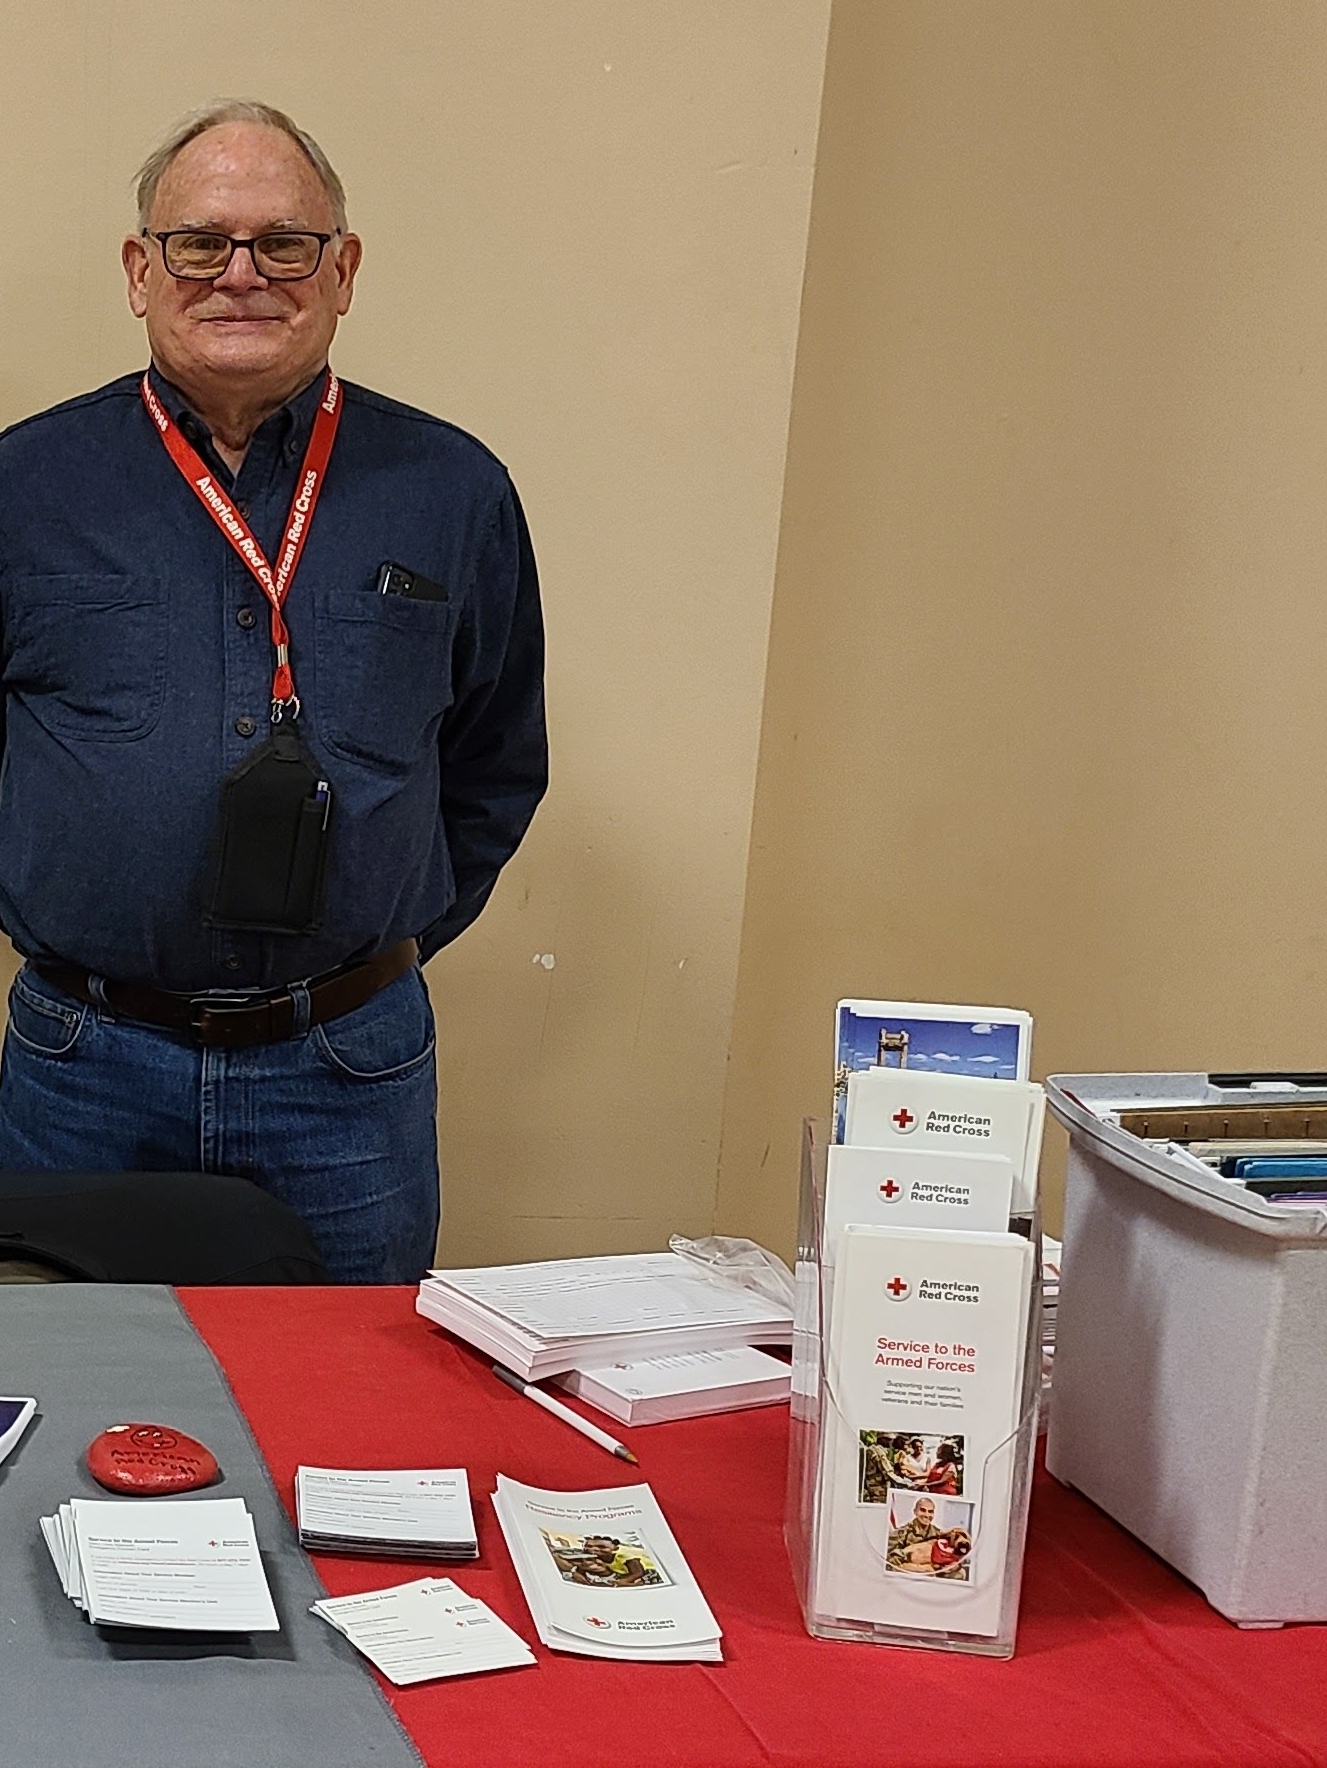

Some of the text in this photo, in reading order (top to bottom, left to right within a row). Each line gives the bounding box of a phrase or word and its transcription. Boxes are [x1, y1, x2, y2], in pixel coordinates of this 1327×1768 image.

[196, 476, 245, 540] American
[239, 538, 265, 567] Red
[276, 470, 317, 596] erican Red Cross
[927, 1111, 991, 1126] American
[925, 1122, 990, 1137] Red Cross
[912, 1182, 970, 1195] American
[910, 1191, 969, 1205] Red Cross
[919, 1279, 980, 1293] American
[918, 1290, 979, 1303] Red Cross
[876, 1337, 976, 1357] Service to the
[874, 1353, 976, 1373] Armed Forces
[886, 1379, 922, 1390] Supporting
[585, 1509, 643, 1520] Programs
